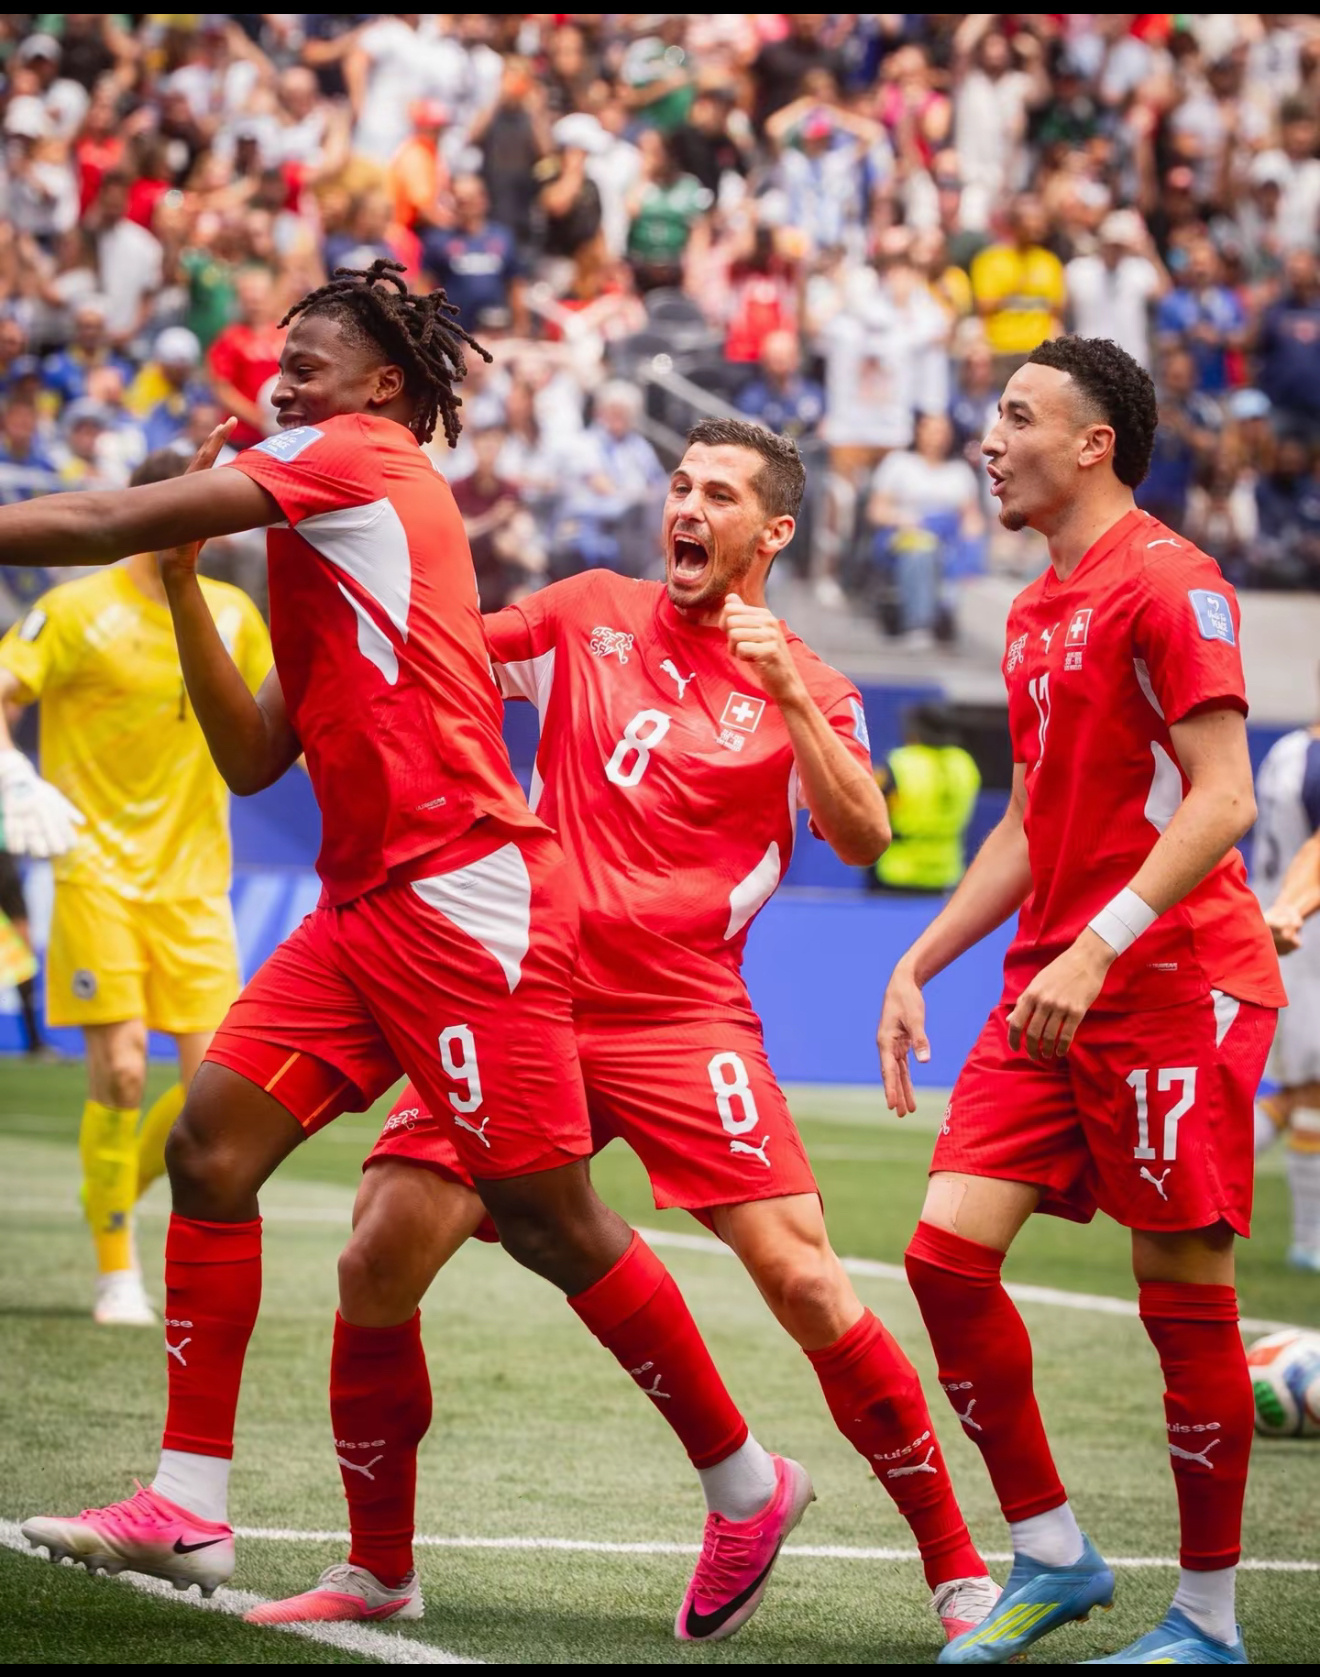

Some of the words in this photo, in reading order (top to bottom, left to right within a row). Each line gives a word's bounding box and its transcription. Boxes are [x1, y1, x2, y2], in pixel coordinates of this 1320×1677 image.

[605, 708, 672, 787] 8
[1028, 672, 1051, 772] 17
[438, 1023, 483, 1113] 9
[707, 1051, 759, 1135] 8
[1125, 1066, 1198, 1160] 17
[873, 1430, 931, 1460] suisse
